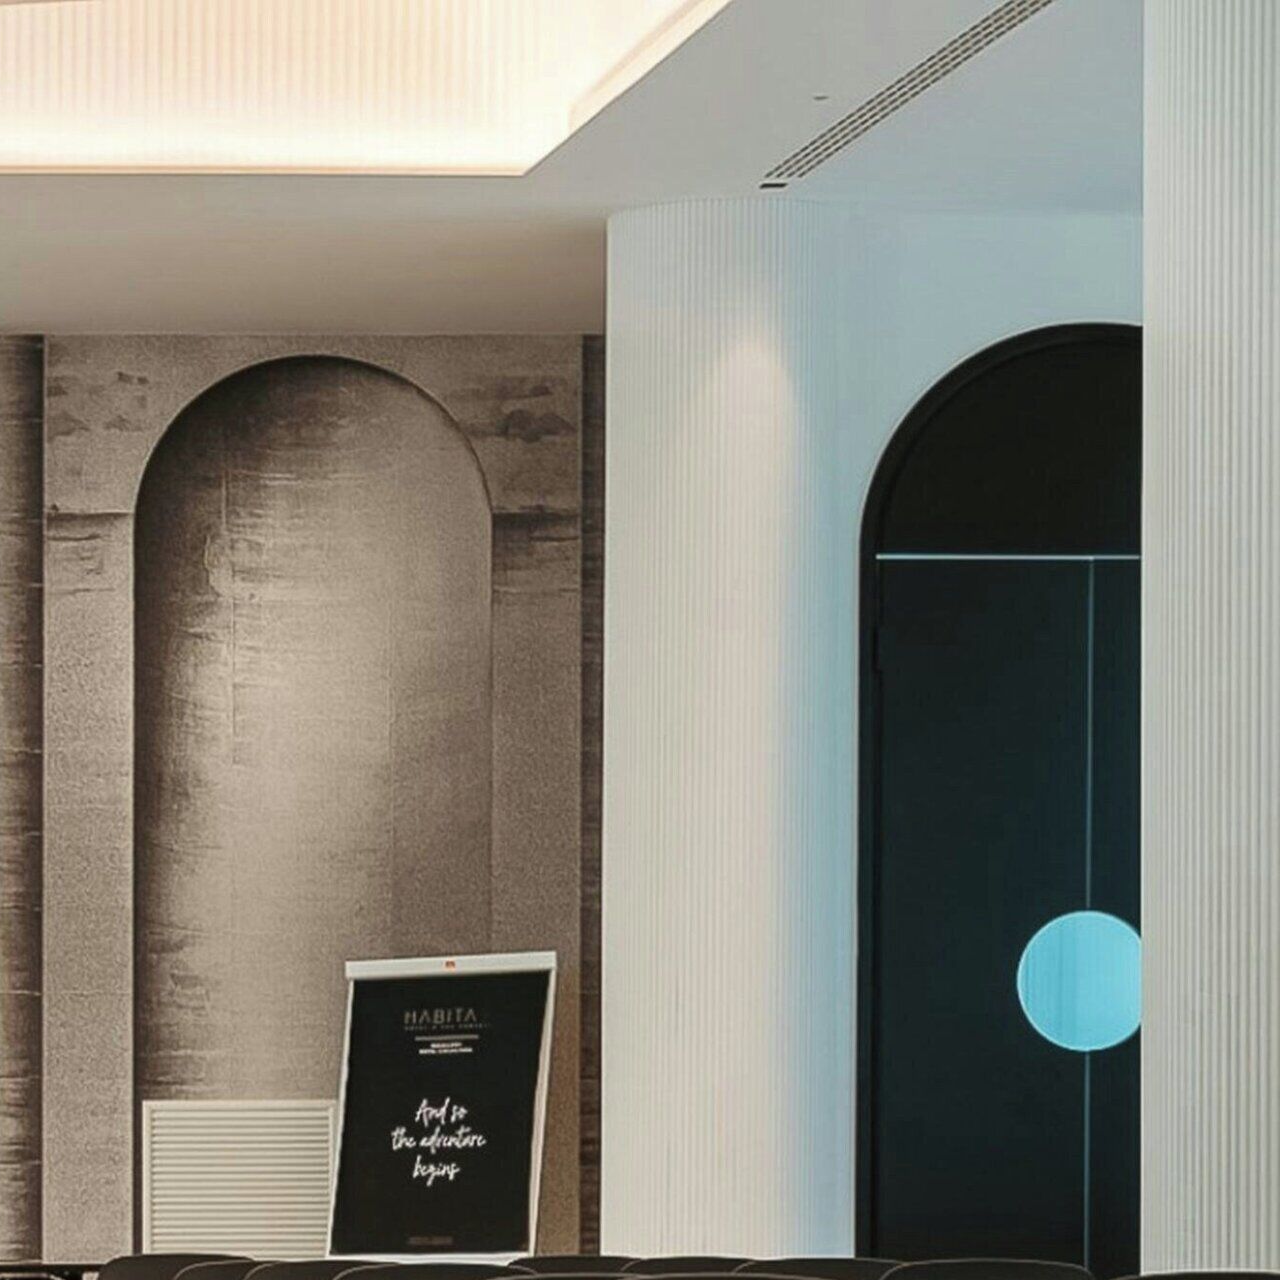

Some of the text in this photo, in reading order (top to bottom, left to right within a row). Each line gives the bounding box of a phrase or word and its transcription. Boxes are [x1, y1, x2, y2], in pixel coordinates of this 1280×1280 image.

[403, 1007, 478, 1025] HABITA
[414, 1096, 468, 1127] And so
[391, 1125, 487, 1154] the adventure
[412, 1154, 461, 1187] begins
